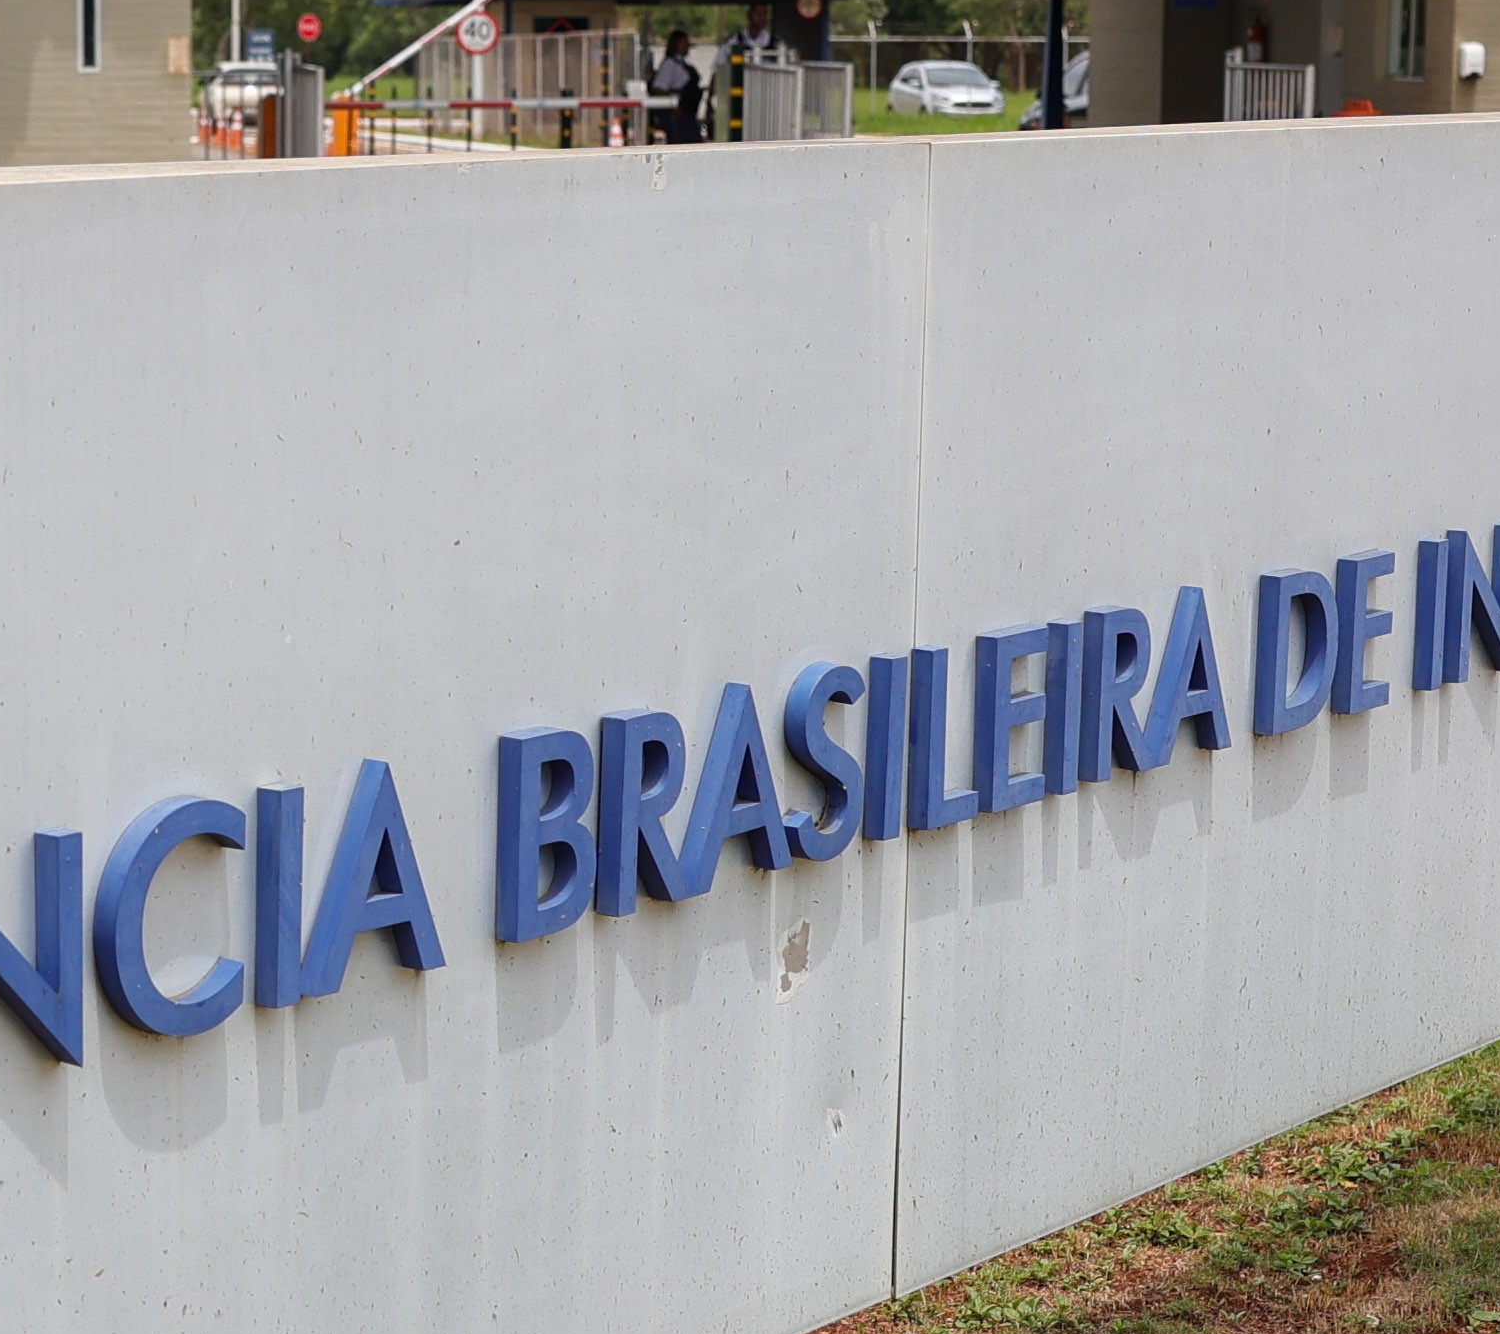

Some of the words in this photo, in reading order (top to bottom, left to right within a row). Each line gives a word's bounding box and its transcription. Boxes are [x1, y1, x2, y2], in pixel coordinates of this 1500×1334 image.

[463, 19, 493, 42] 40
[496, 586, 1231, 944] BRASILEIRA
[1252, 549, 1396, 737] DE
